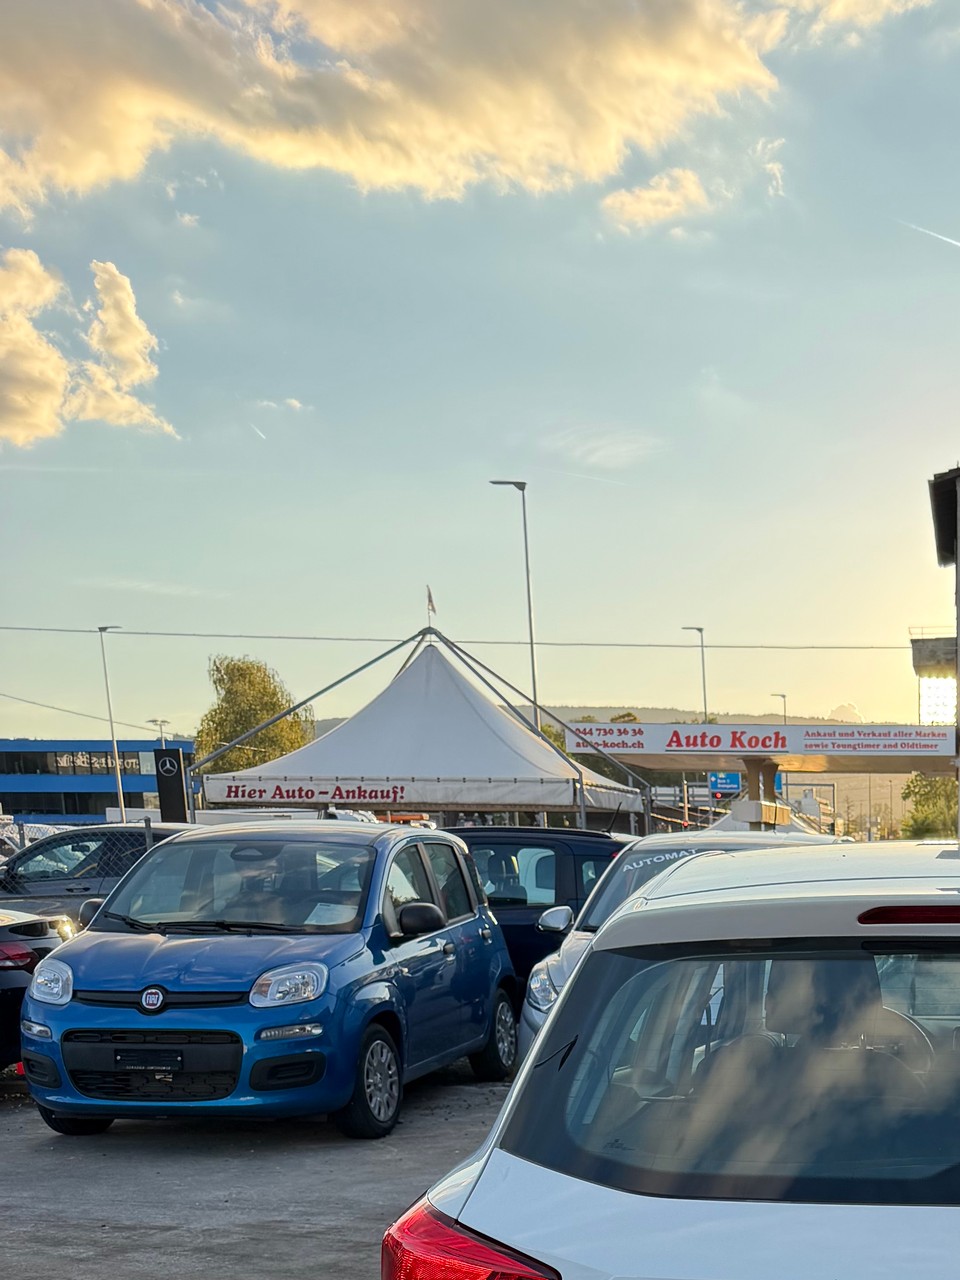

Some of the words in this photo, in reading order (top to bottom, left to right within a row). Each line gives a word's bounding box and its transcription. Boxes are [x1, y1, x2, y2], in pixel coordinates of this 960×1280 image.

[596, 728, 614, 737] 730
[617, 728, 631, 737] 36
[631, 728, 644, 737] 36
[804, 730, 836, 738] Ankauf
[838, 730, 855, 738] und
[857, 730, 891, 738] Verkauf
[893, 730, 913, 738] aller
[666, 729, 722, 748] Auto
[730, 731, 787, 749] Koch
[575, 740, 644, 749] auo-koch.ch
[830, 742, 880, 751] Youngtimer
[226, 785, 267, 799] Hier
[146, 994, 159, 1004] FIAT
